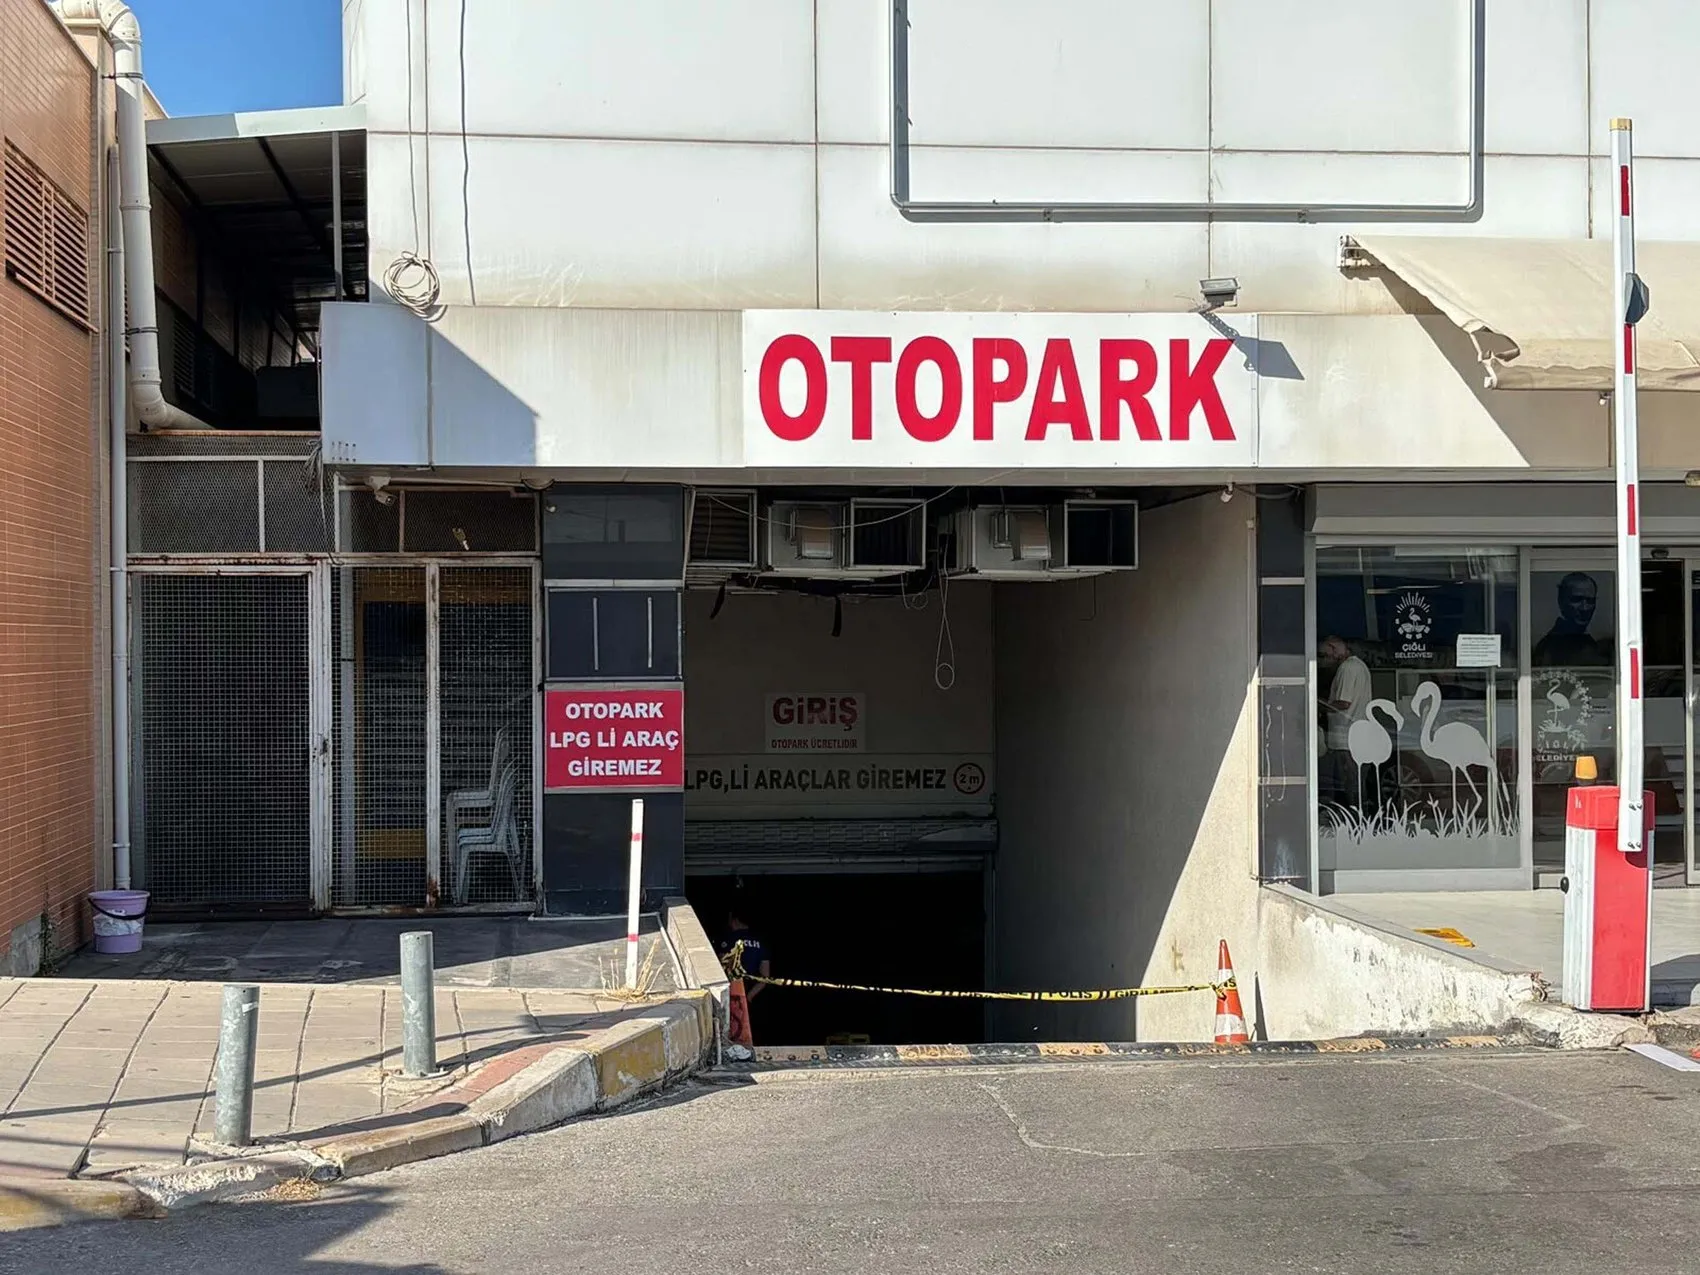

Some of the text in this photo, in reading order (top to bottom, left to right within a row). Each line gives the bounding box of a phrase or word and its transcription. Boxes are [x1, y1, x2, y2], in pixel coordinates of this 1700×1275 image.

[759, 334, 1236, 442] OTOPARK
[565, 702, 664, 719] OTOPARK
[550, 727, 679, 750] LPG Lİ ARAÇ
[772, 739, 809, 749] OTOPARK
[568, 756, 662, 776] GİREMEZ
[754, 769, 850, 791] ARAÇLAR
[857, 764, 947, 789] GİREMEZ
[959, 774, 967, 784] 2
[969, 775, 980, 785] m
